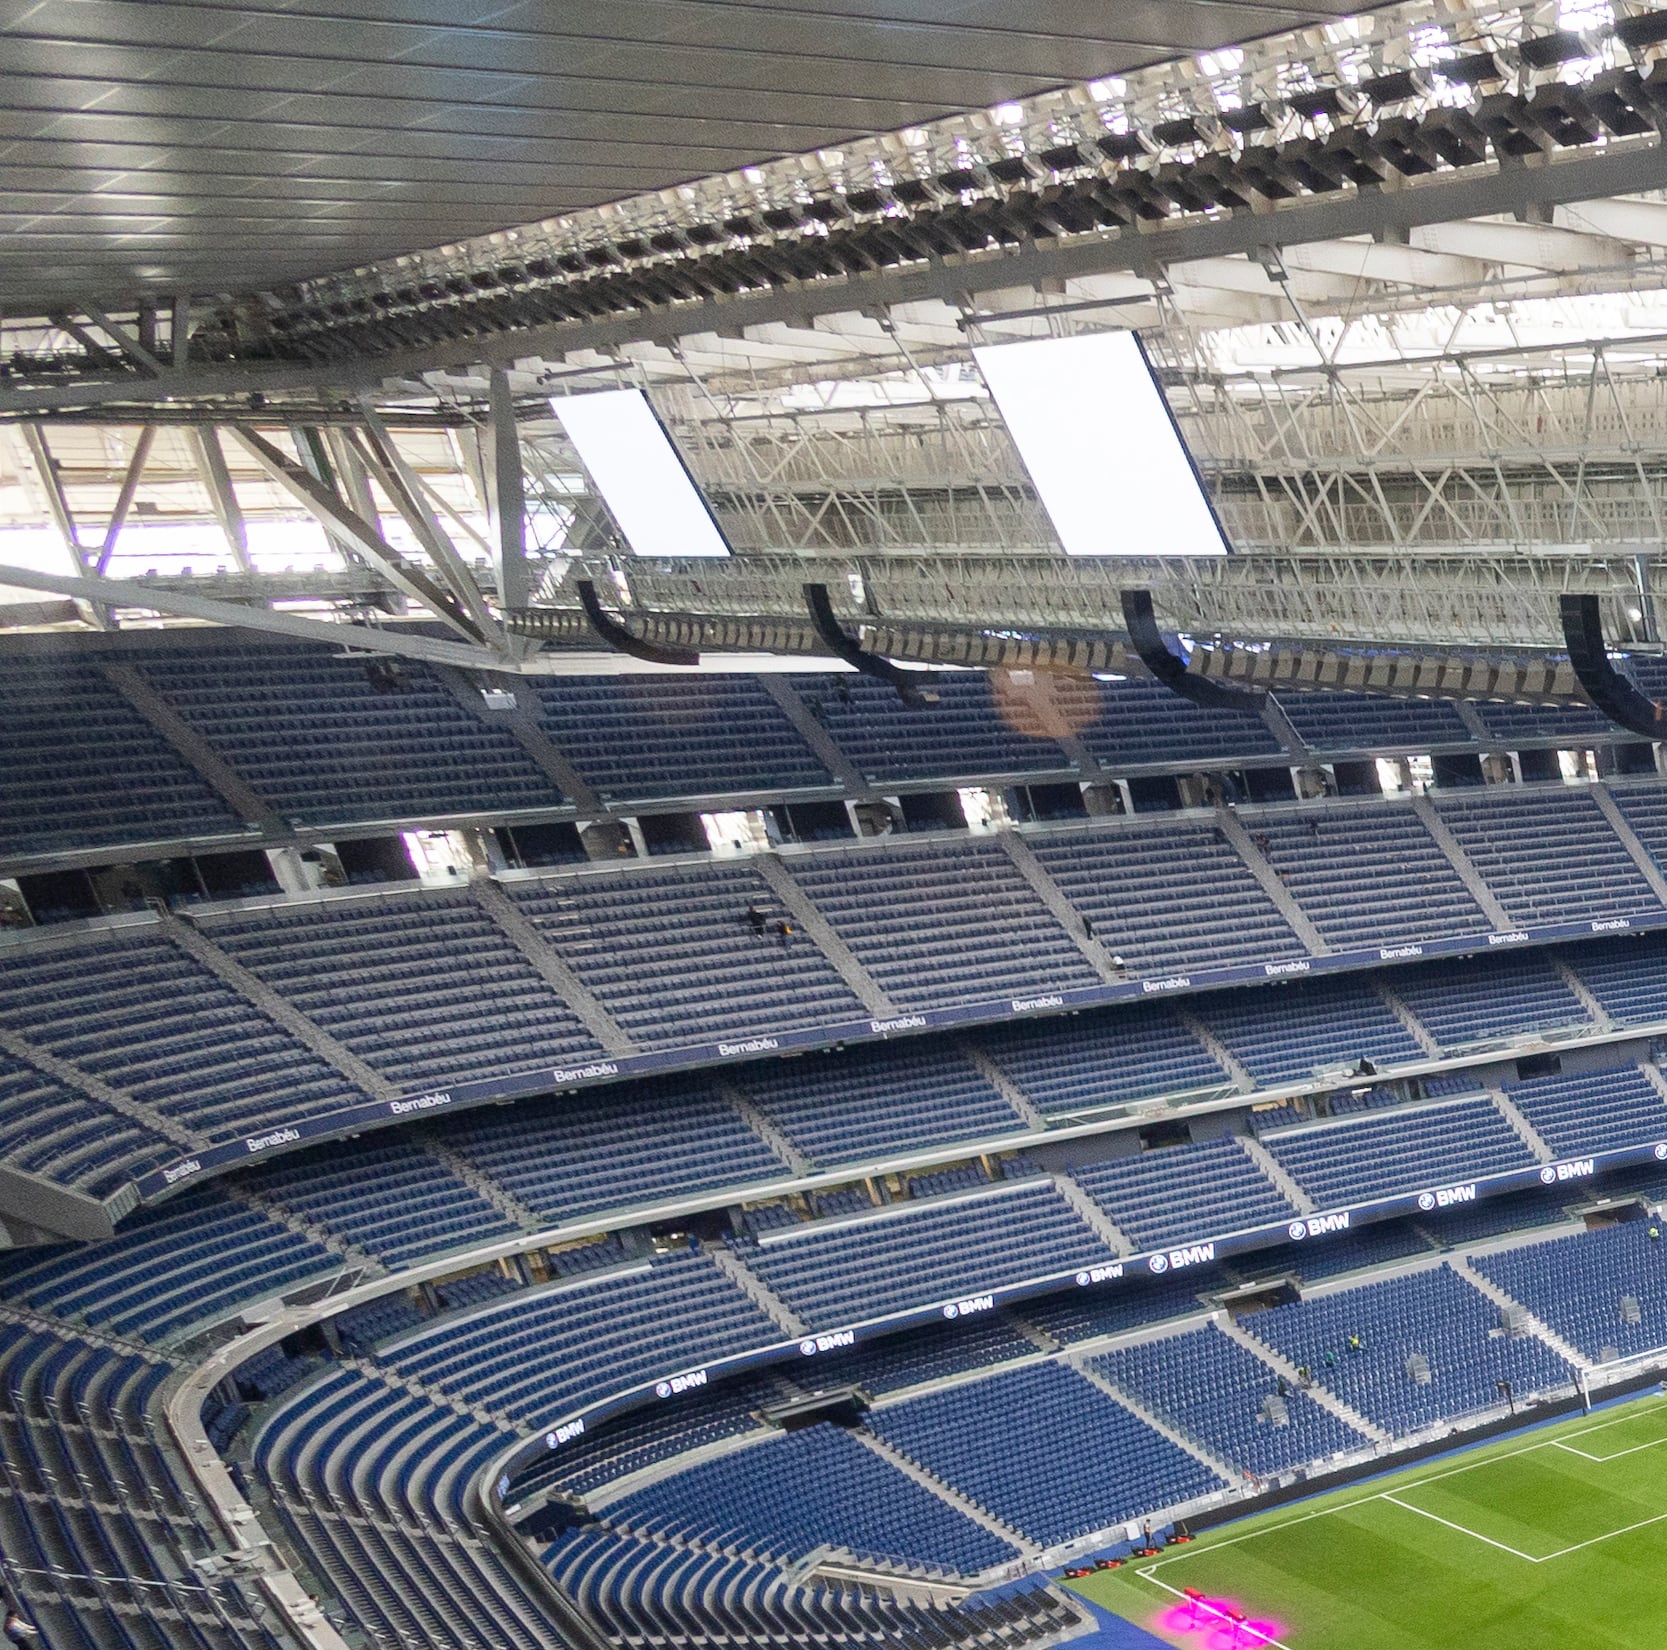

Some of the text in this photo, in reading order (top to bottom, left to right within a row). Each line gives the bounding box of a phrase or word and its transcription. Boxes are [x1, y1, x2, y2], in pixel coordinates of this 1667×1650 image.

[1591, 918, 1630, 931] Bernabéu
[1488, 931, 1528, 944] Bernabéu
[1380, 945, 1422, 959] Bernabéu
[1265, 961, 1310, 976] Bernabéu
[1142, 977, 1190, 992] Bernabéu
[1012, 995, 1063, 1011] Bernabéu
[871, 1015, 926, 1033] Bernabéu
[718, 1038, 778, 1056] Bernabéu
[554, 1062, 618, 1082] Bernabéu
[390, 1091, 450, 1114] Bernabéu
[246, 1128, 300, 1151] Bernabéu
[1557, 1160, 1594, 1179] BMW
[1437, 1185, 1476, 1206] BMW
[1308, 1213, 1350, 1235] BMW
[1171, 1244, 1215, 1268] BMW
[1090, 1264, 1124, 1282] BMW
[958, 1295, 993, 1315] BMW
[816, 1330, 855, 1351] BMW
[673, 1371, 707, 1394] BMW
[557, 1418, 585, 1444] BMW
